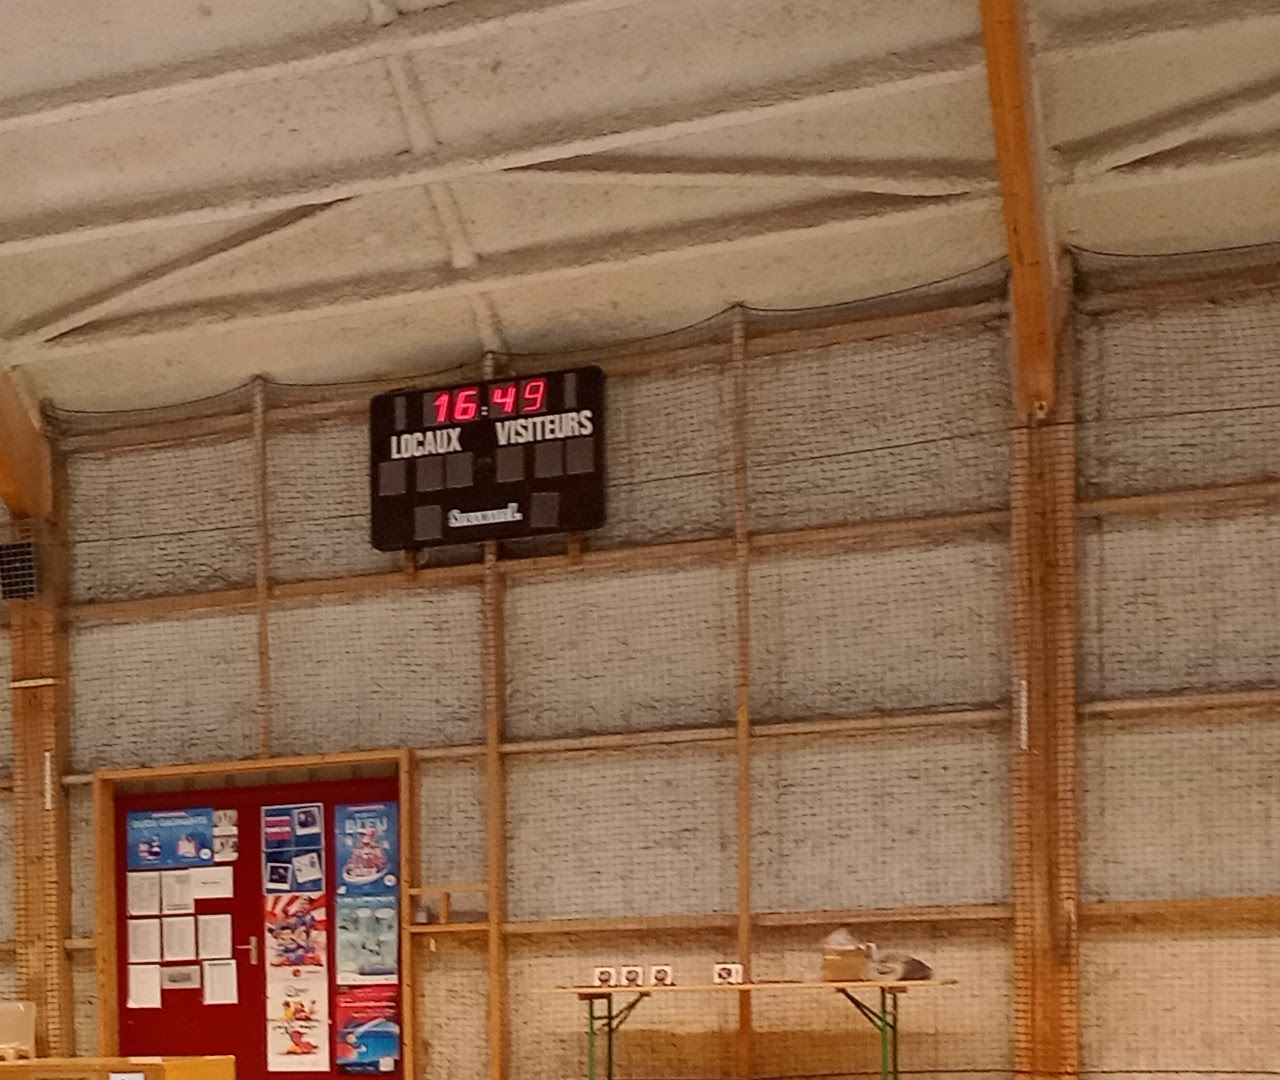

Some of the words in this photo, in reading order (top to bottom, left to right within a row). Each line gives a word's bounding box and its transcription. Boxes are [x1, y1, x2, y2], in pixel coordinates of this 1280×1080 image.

[433, 378, 546, 422] 16:49
[391, 427, 462, 459] LOCAUX
[495, 410, 593, 445] VISITEURS
